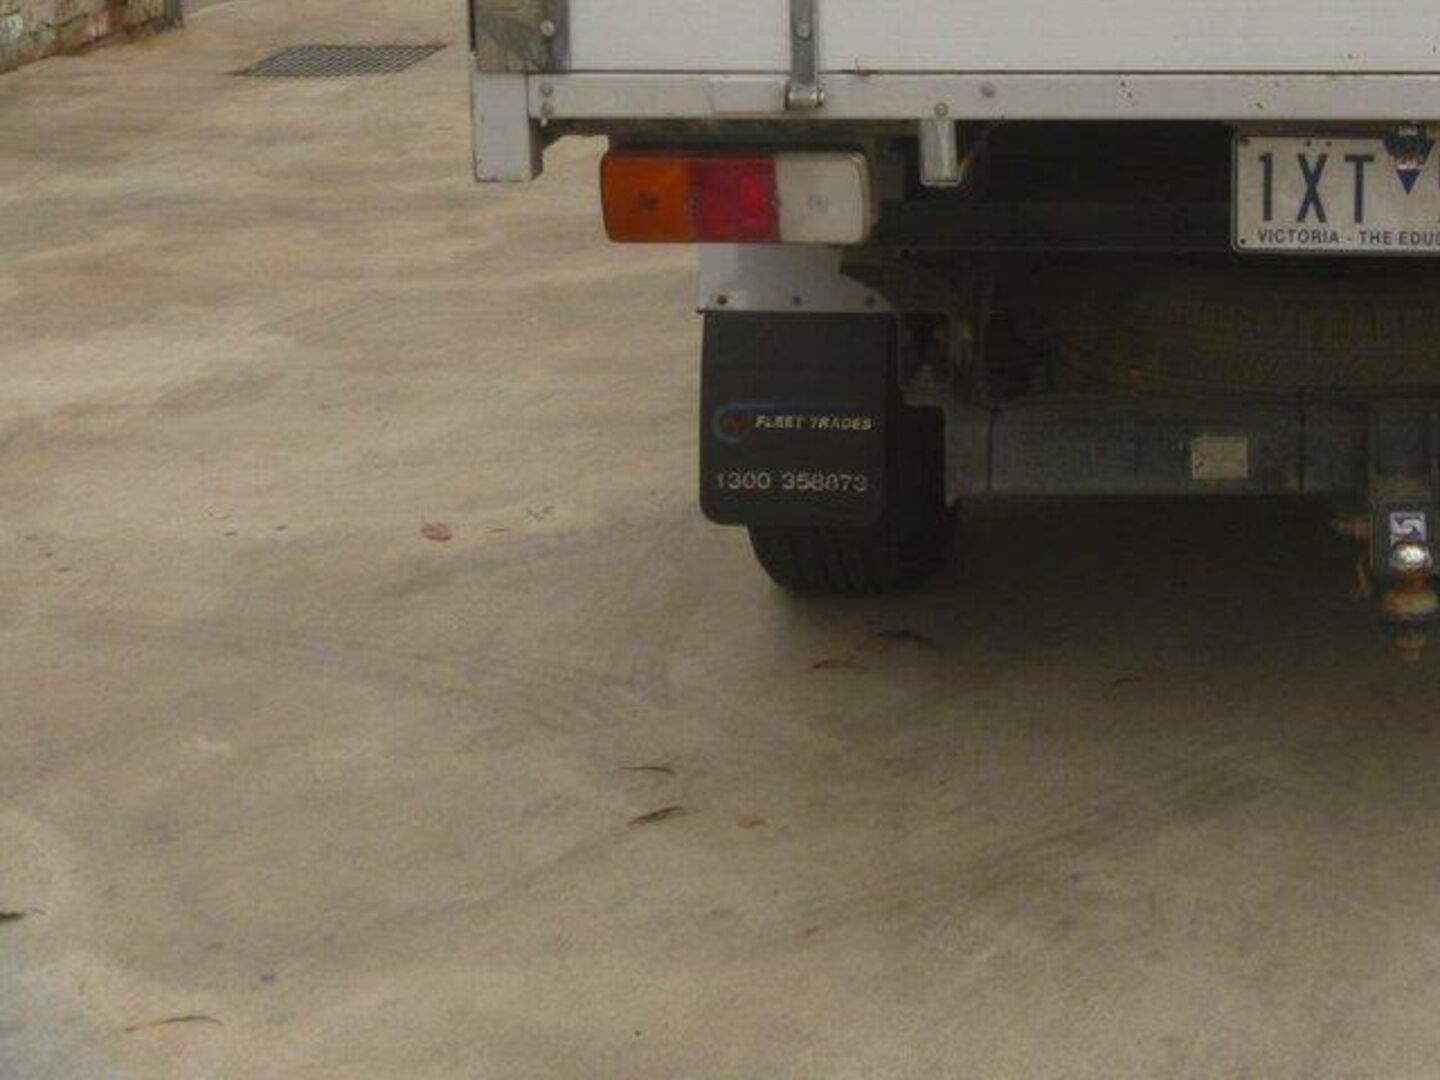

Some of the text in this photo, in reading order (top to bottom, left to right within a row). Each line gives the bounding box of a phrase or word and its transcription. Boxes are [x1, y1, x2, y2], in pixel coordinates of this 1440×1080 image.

[1258, 152, 1375, 223] 1XT
[1258, 229, 1340, 245] VICTORIA
[1360, 230, 1393, 246] THE
[755, 415, 872, 431] FLEET TRADES
[717, 472, 771, 490] 1300
